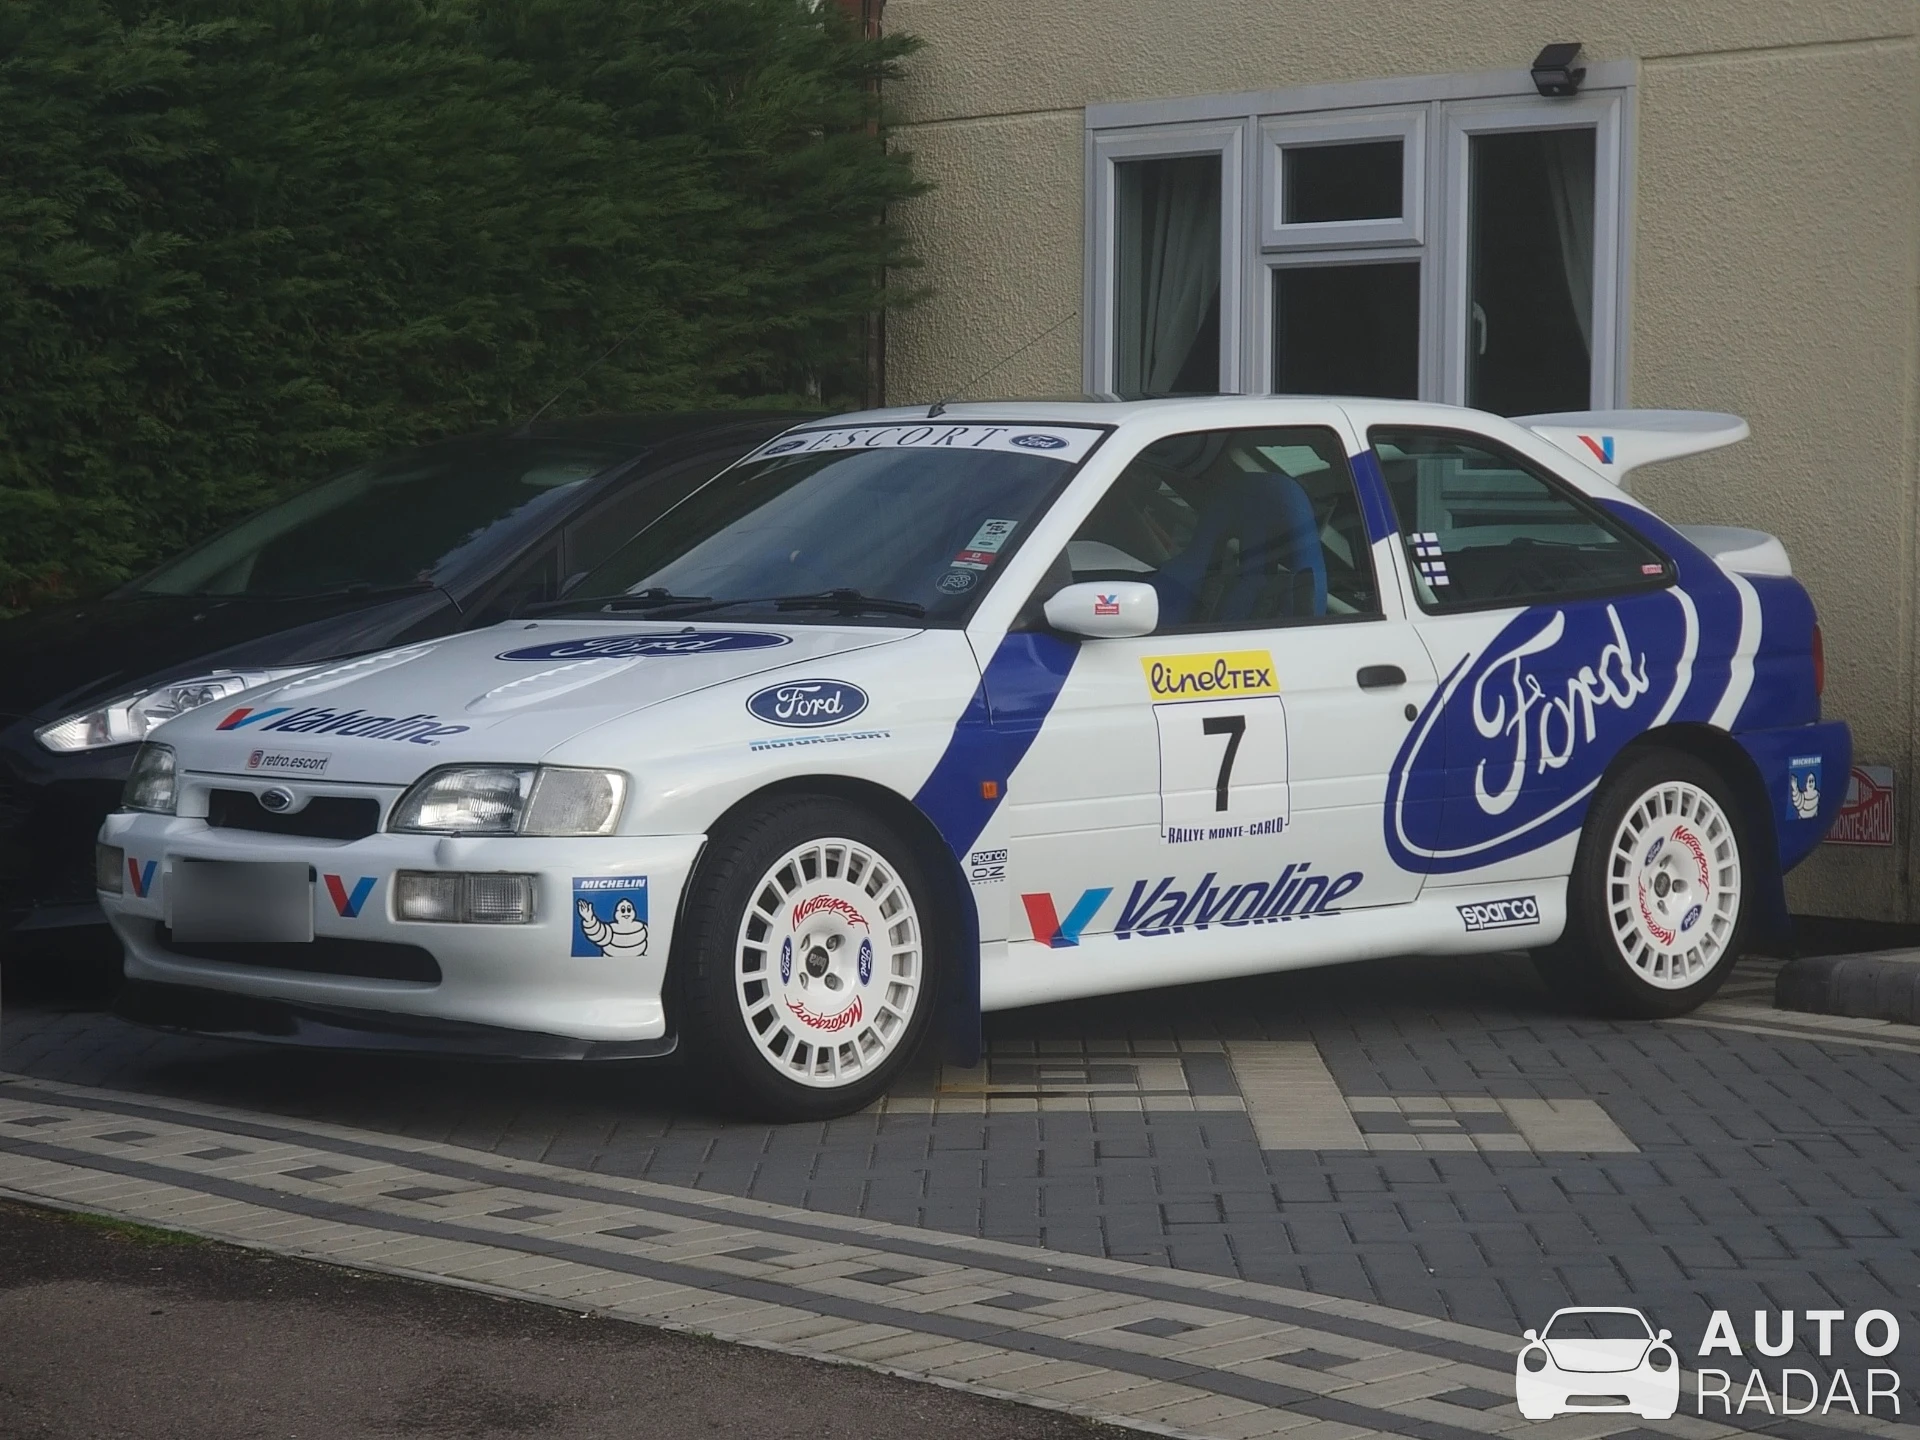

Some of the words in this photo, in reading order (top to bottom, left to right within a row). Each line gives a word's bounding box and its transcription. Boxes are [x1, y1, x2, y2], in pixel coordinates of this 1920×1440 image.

[805, 426, 1008, 451] ESCORT
[550, 634, 734, 657] Ford
[775, 685, 844, 719] Ford
[1473, 604, 1649, 815] Ford
[259, 706, 471, 745] Valvoline
[749, 729, 891, 752] MOTORSPORT
[261, 753, 328, 771] retro.escort
[1202, 714, 1246, 812] 7
[1168, 827, 1205, 844] RALLYE
[1209, 816, 1284, 840] MONTE-CARLO
[972, 850, 1007, 863] sparco
[1669, 825, 1710, 902] Motorsport
[580, 879, 646, 889] MICHELIN
[1113, 861, 1364, 940] Valvoline
[792, 894, 870, 934] Motorsport
[1461, 898, 1537, 930] sparco
[1638, 869, 1677, 946] Motorsport
[783, 994, 863, 1033] Motorsport
